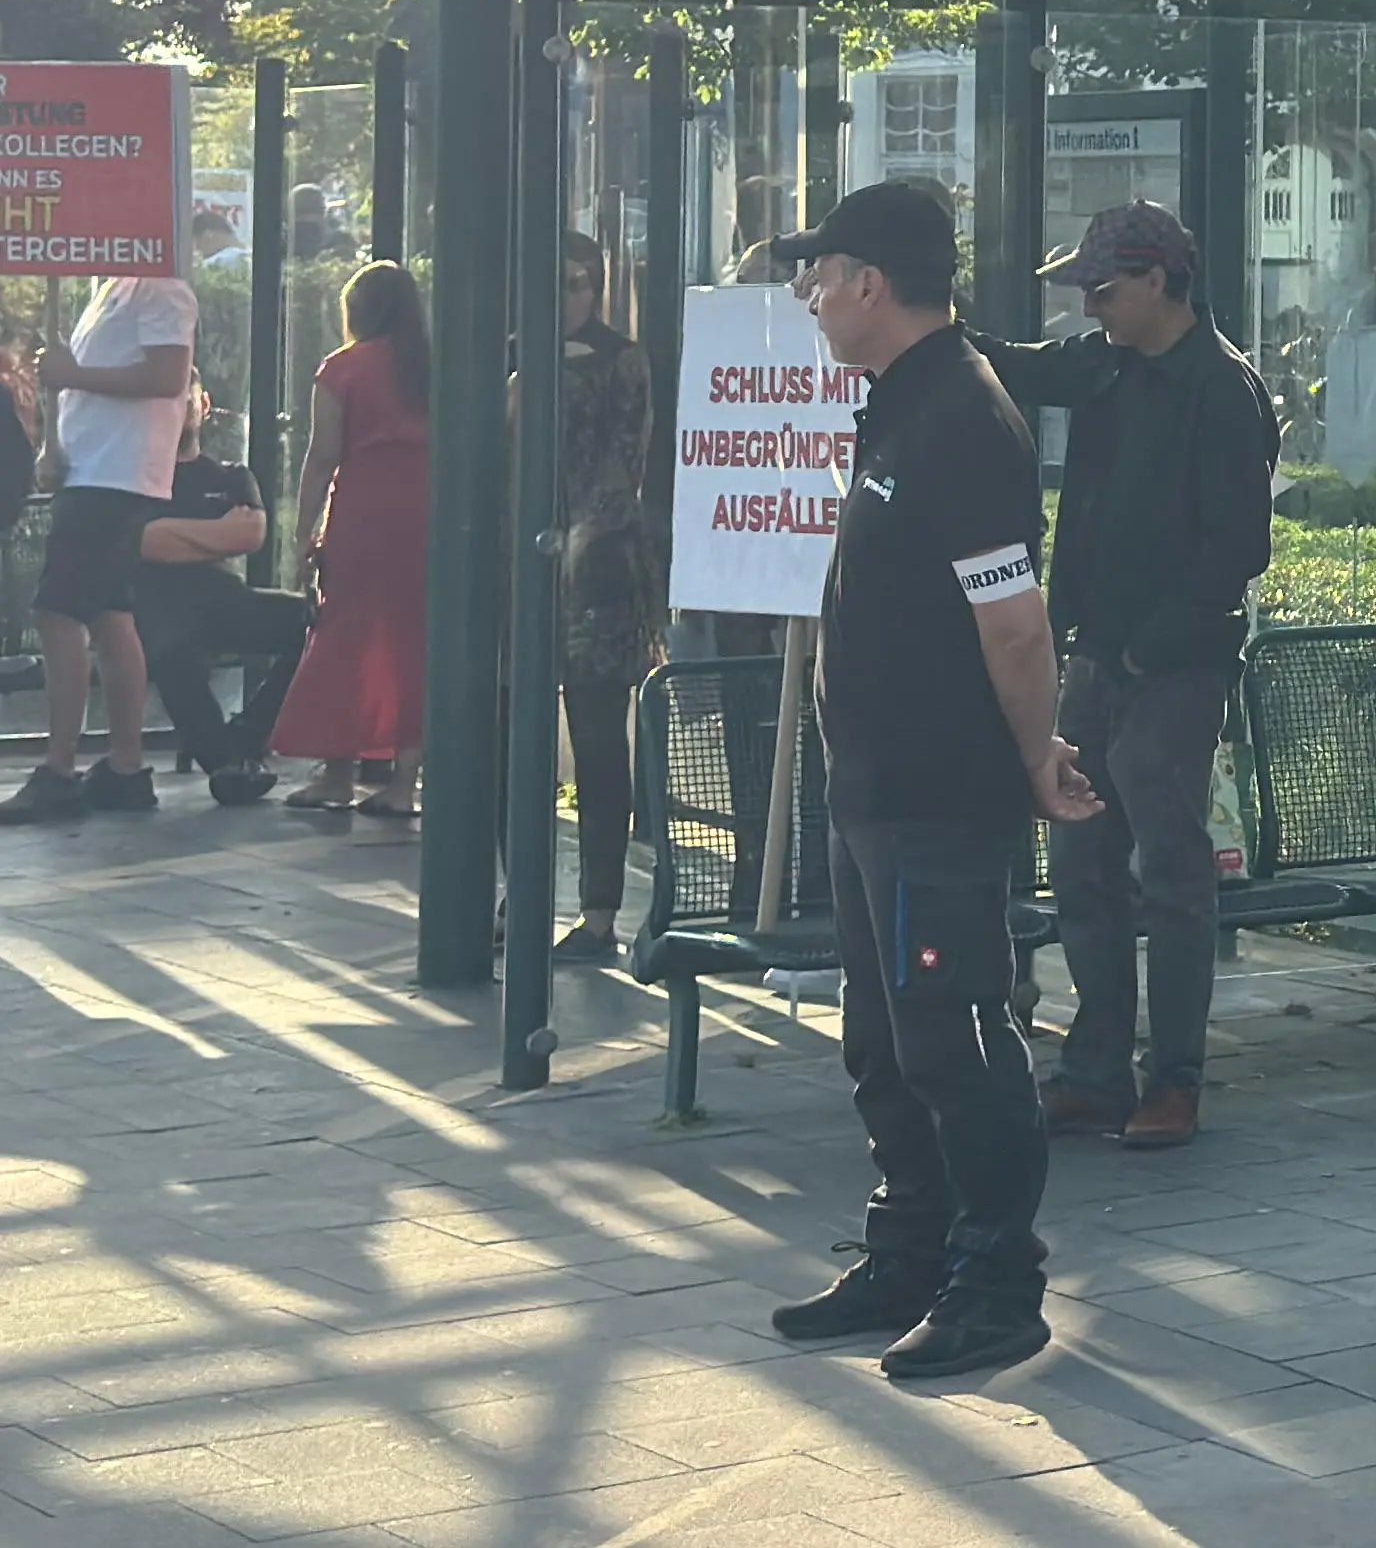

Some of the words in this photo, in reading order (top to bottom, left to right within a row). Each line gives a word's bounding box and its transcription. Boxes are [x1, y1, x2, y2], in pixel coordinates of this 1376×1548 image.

[0, 133, 142, 157] OLLEGEN?
[1053, 127, 1130, 151] Information
[36, 169, 62, 189] ES
[5, 195, 61, 232] HT
[709, 366, 814, 404] SCHLUSS
[821, 366, 867, 404] MIT
